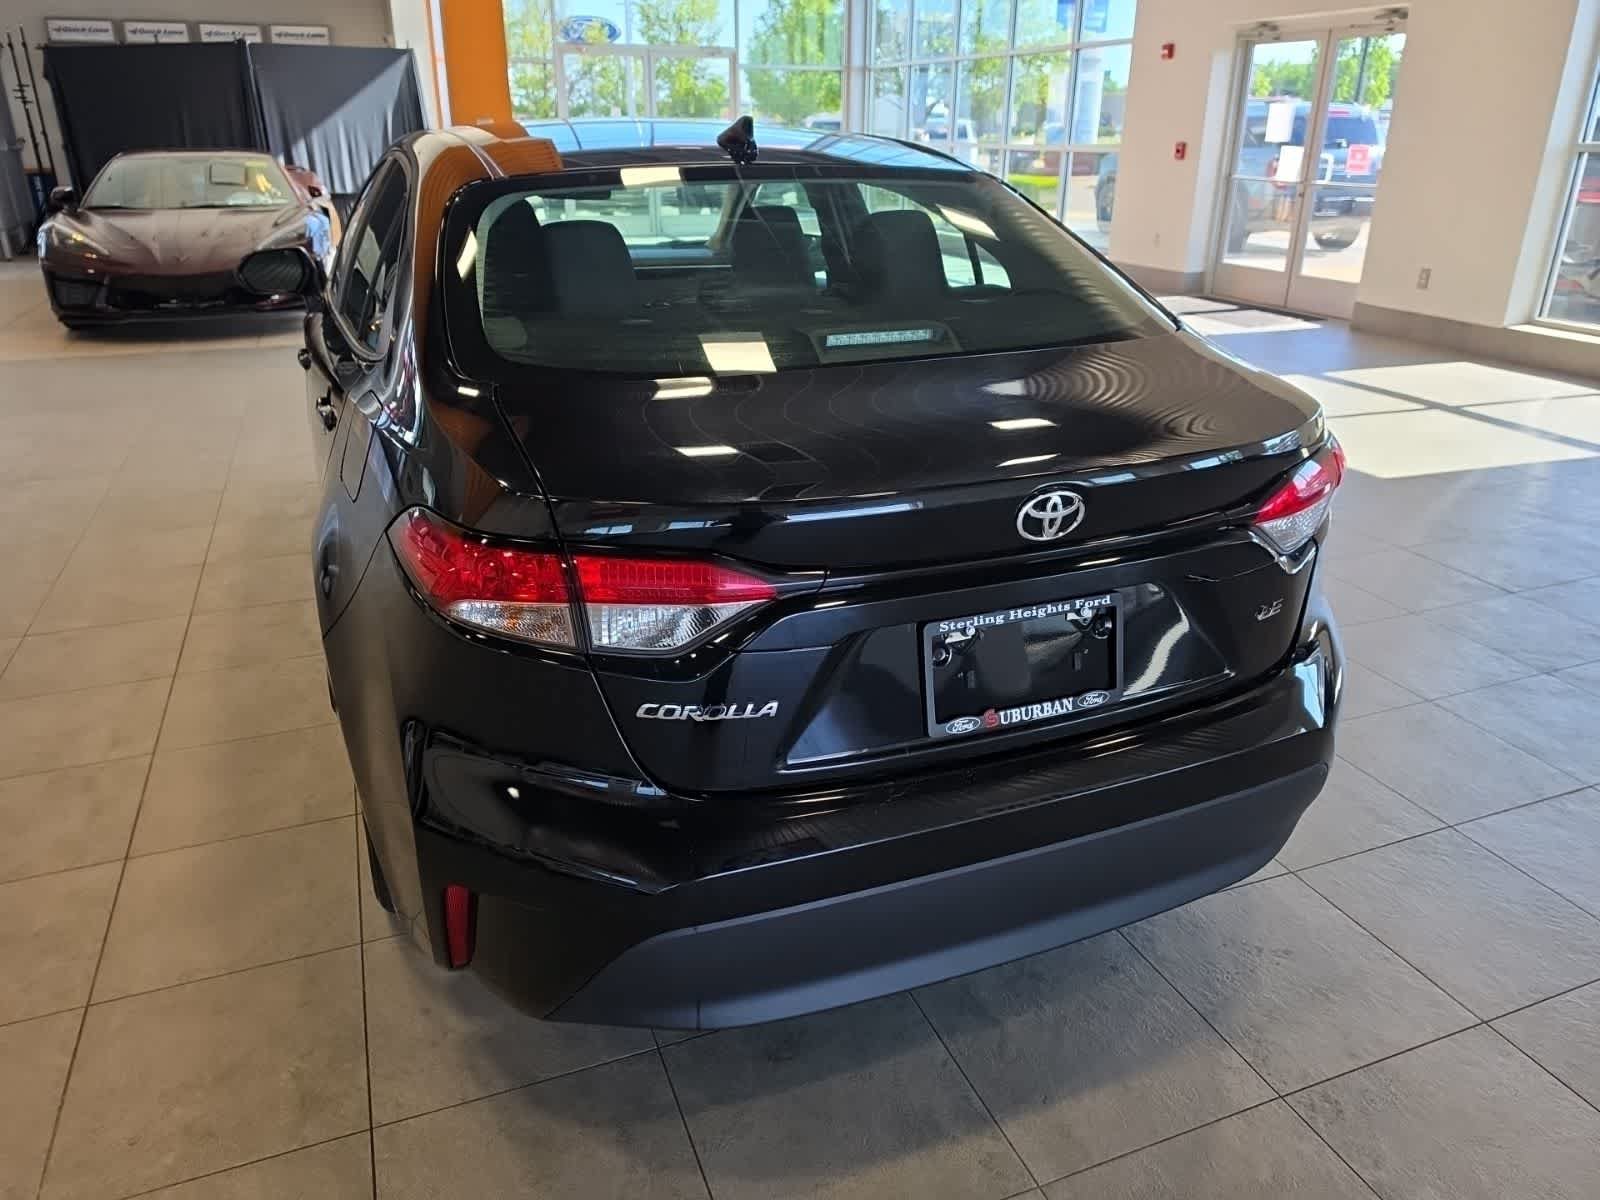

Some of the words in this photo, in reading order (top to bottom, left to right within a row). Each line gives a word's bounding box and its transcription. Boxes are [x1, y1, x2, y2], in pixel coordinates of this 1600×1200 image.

[939, 613, 1004, 633] Sterling
[1009, 603, 1071, 620] Heights
[1075, 595, 1112, 609] Ford
[636, 701, 778, 721] COROLLA
[983, 697, 1074, 727] SUBURBAN
